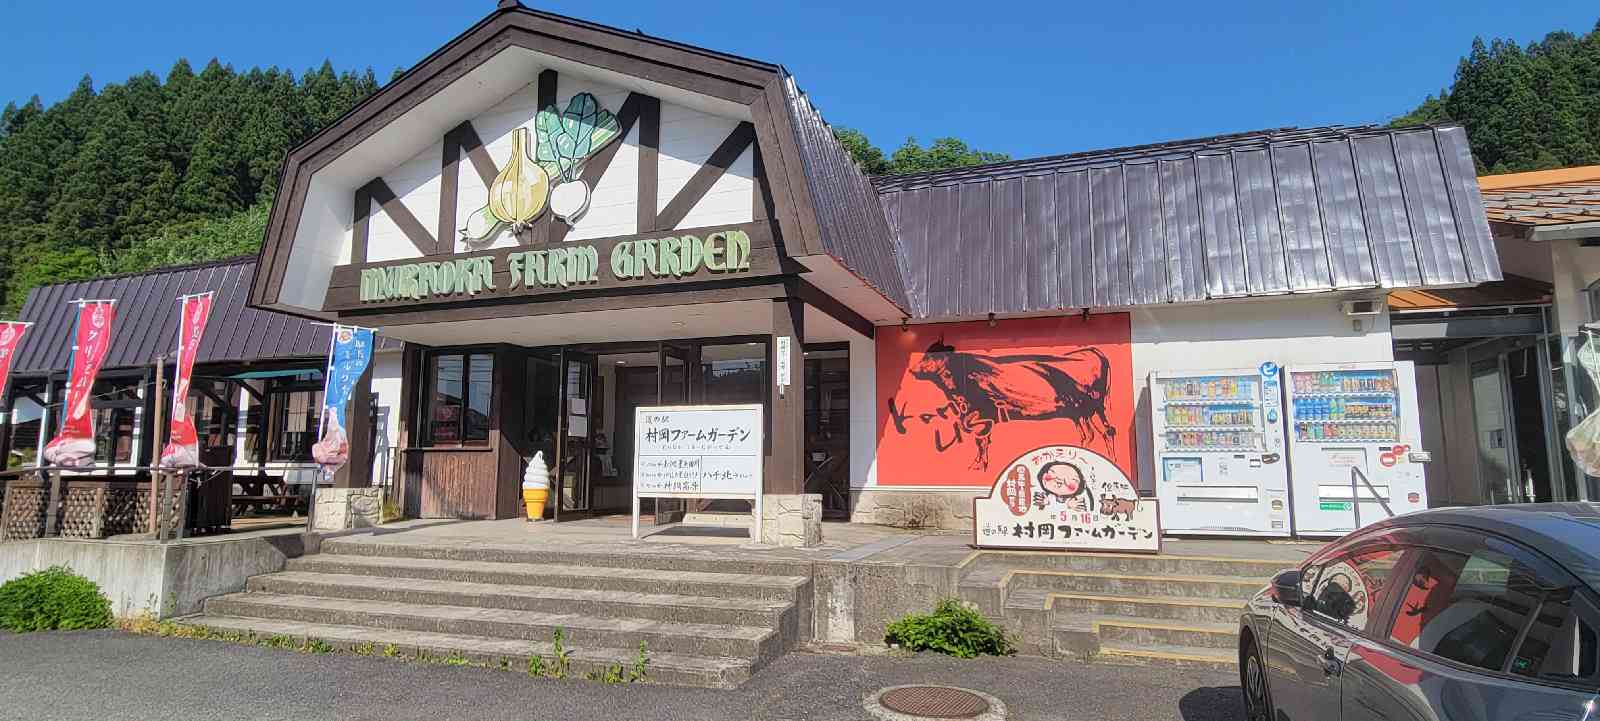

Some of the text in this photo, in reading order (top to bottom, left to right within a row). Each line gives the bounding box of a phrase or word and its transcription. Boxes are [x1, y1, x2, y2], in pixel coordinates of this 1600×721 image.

[360, 230, 752, 302] MURAOKA FARM GARDEN
[646, 426, 751, 443] 村岡ファームガーデン
[1013, 521, 1153, 540] 村岡ファームガーデン
